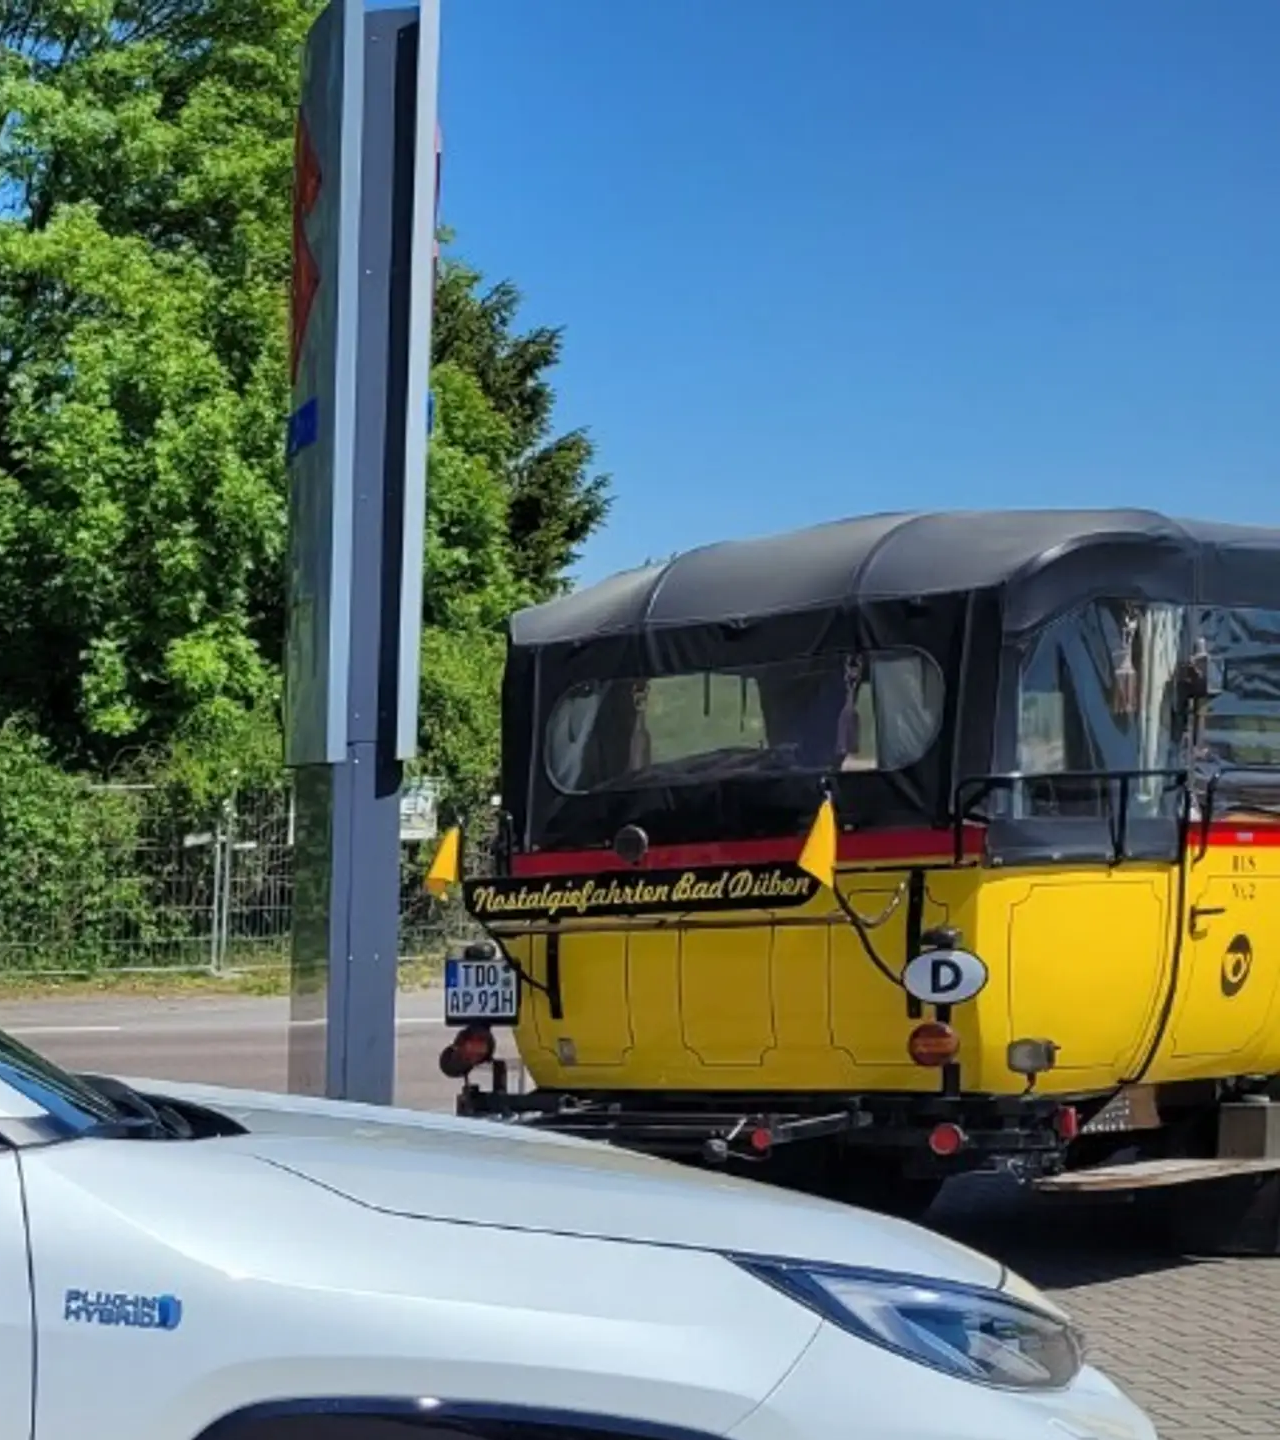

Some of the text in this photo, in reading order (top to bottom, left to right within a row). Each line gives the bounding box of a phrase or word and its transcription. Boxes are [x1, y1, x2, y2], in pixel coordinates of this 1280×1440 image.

[473, 869, 810, 914] Nostalgiefahrten Bad Düben
[462, 965, 499, 988] TDO
[930, 959, 963, 995] D
[450, 990, 474, 1014] AP
[65, 1289, 158, 1311] PLUG-IN
[64, 1304, 158, 1329] HYBRID
